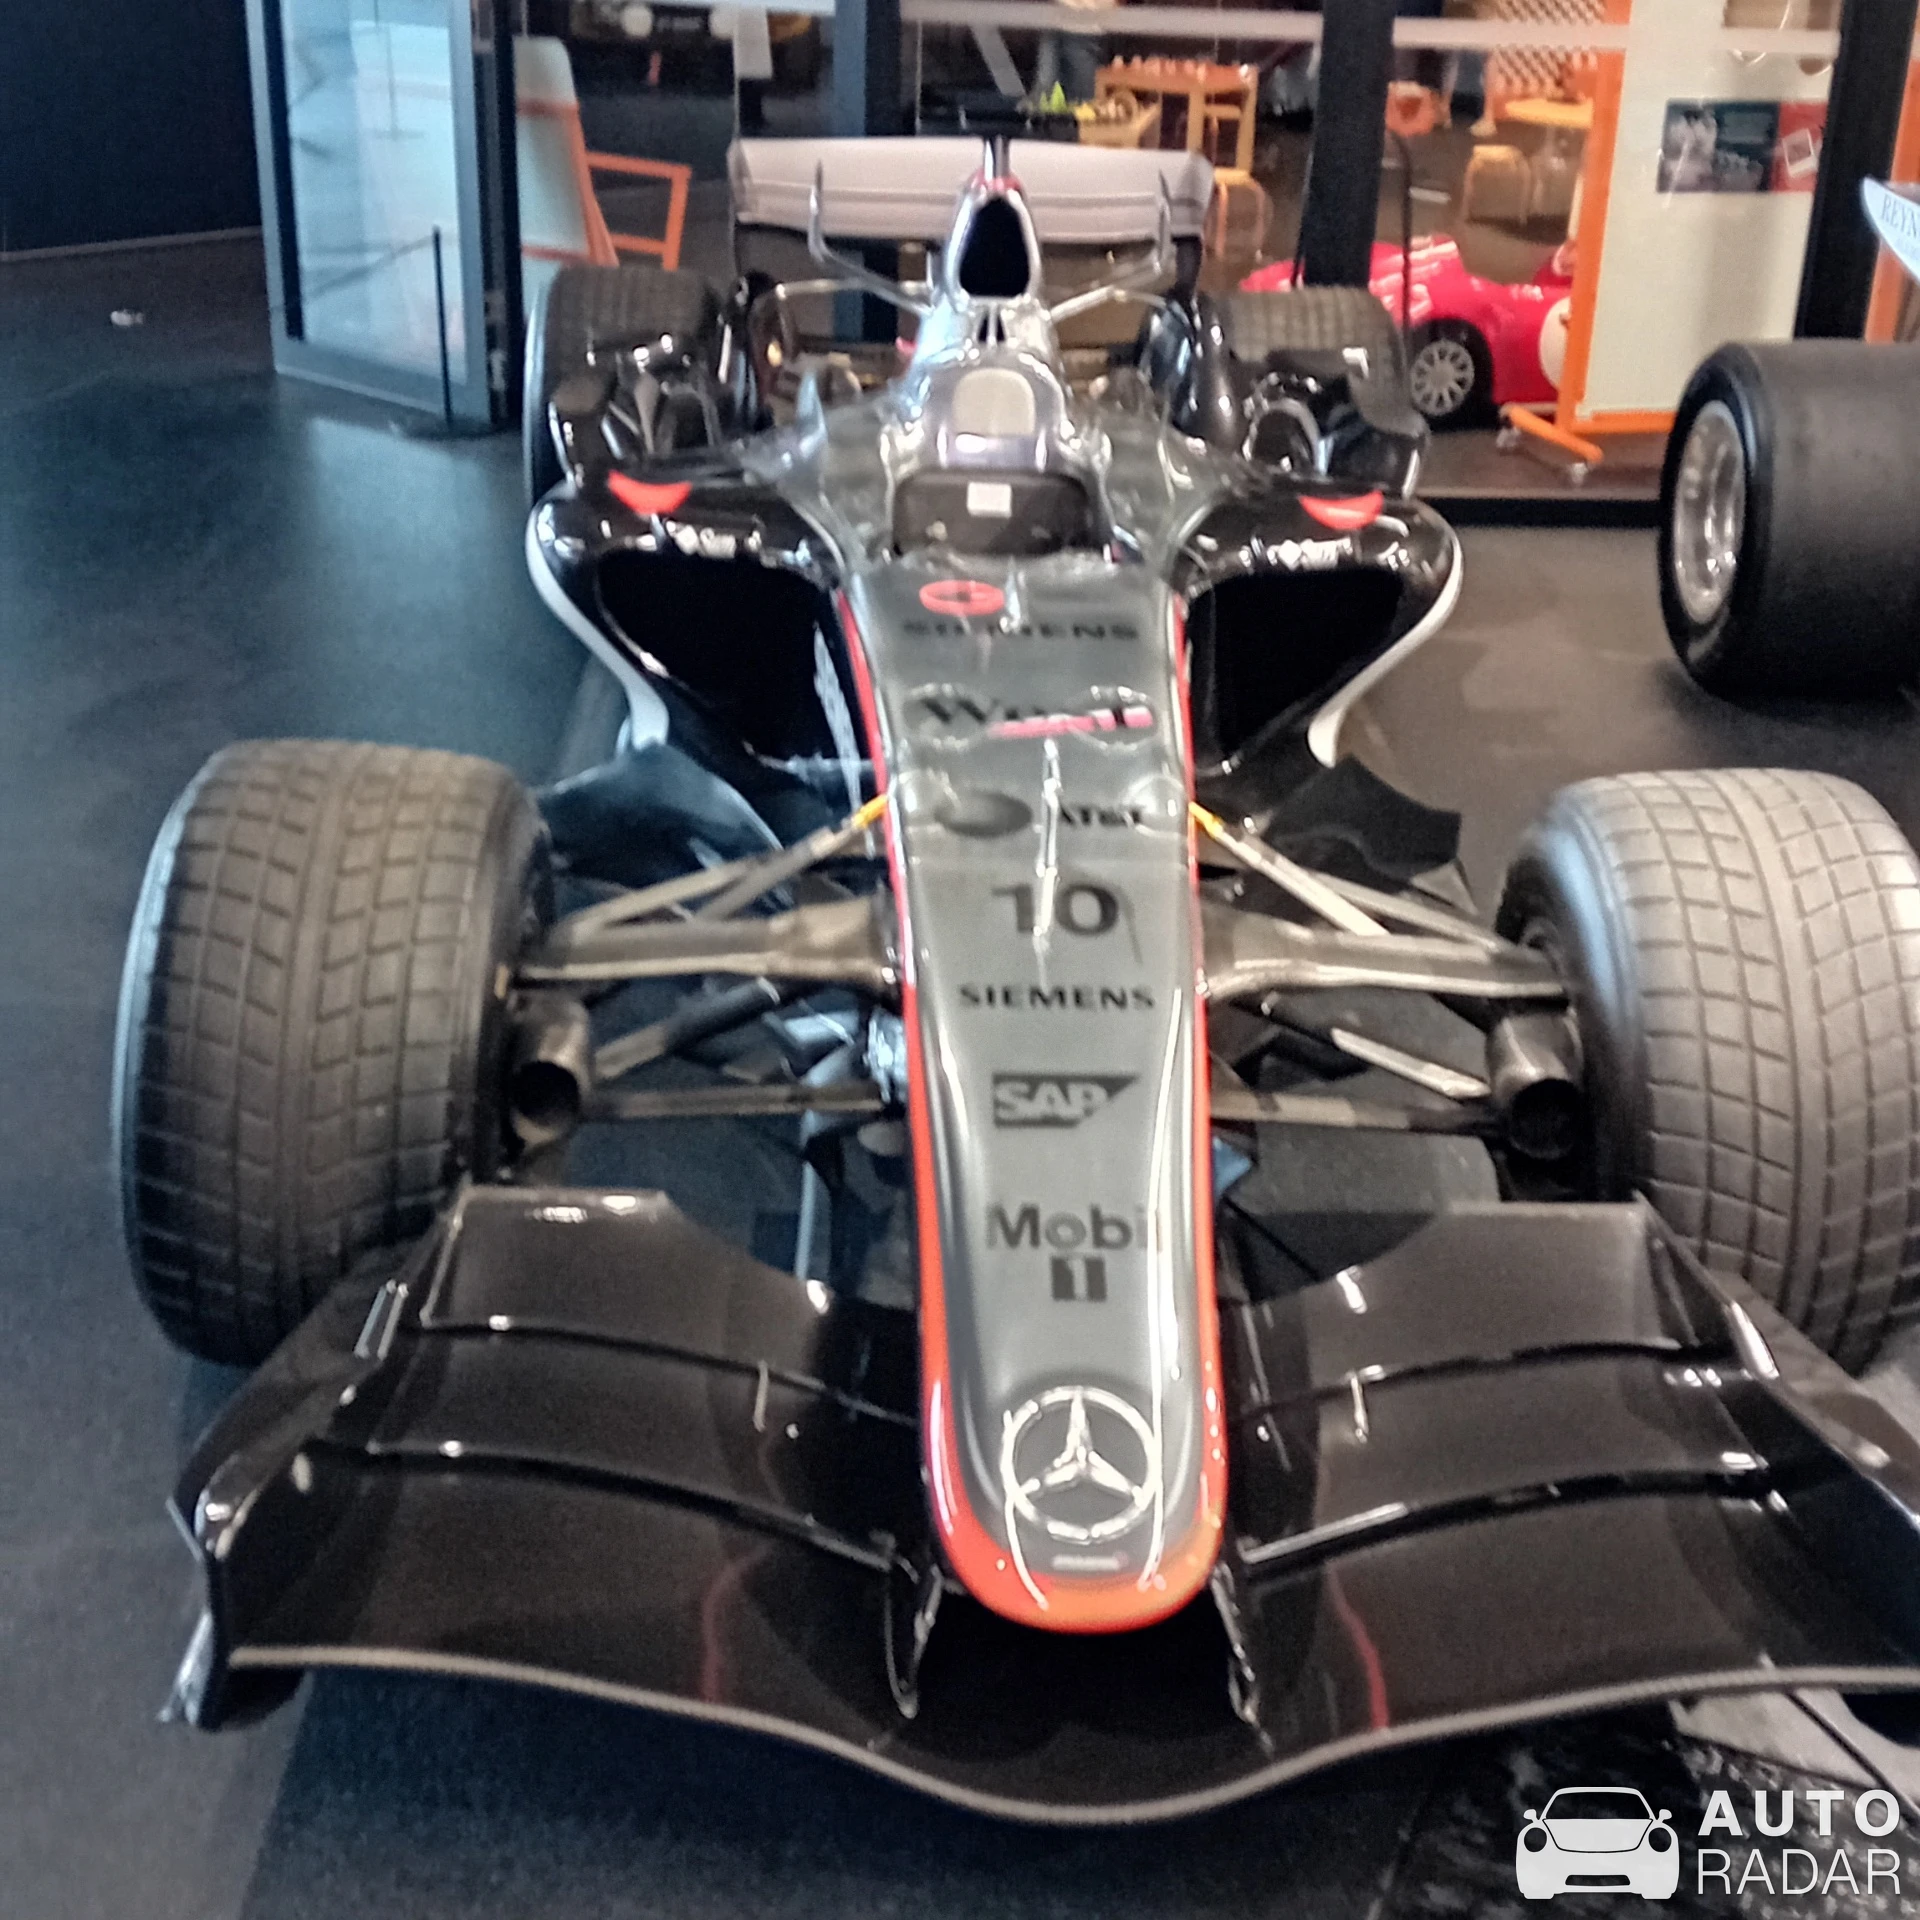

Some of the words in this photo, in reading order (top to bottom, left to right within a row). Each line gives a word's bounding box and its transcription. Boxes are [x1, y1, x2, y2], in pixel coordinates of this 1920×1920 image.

[991, 883, 1119, 937] 10
[959, 985, 1155, 1010] SIEMENS
[993, 1079, 1110, 1122] SAP
[986, 1202, 1160, 1250] Mobi
